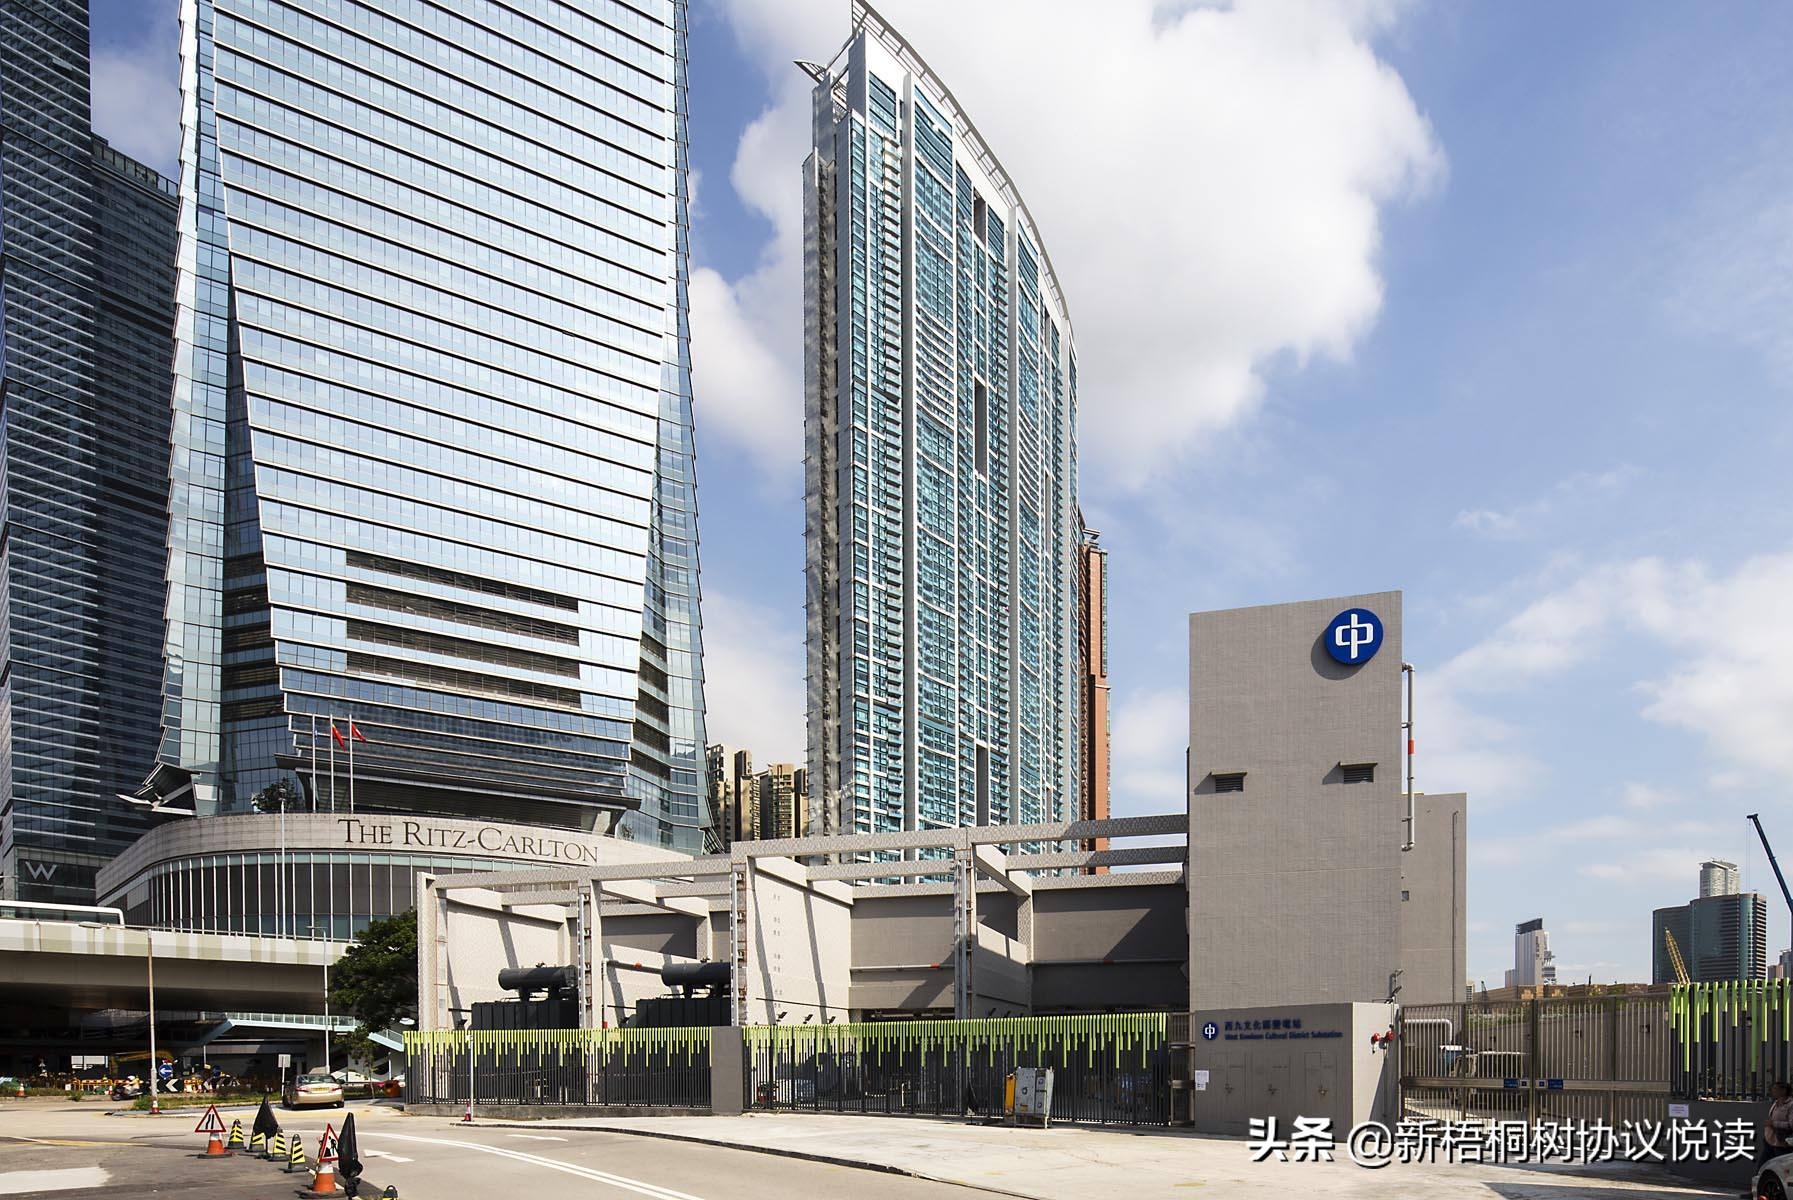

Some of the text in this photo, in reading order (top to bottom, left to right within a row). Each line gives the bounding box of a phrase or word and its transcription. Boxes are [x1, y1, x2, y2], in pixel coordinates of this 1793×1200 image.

[337, 819, 599, 863] THE RITZ-CARLTON
[25, 861, 58, 880] W
